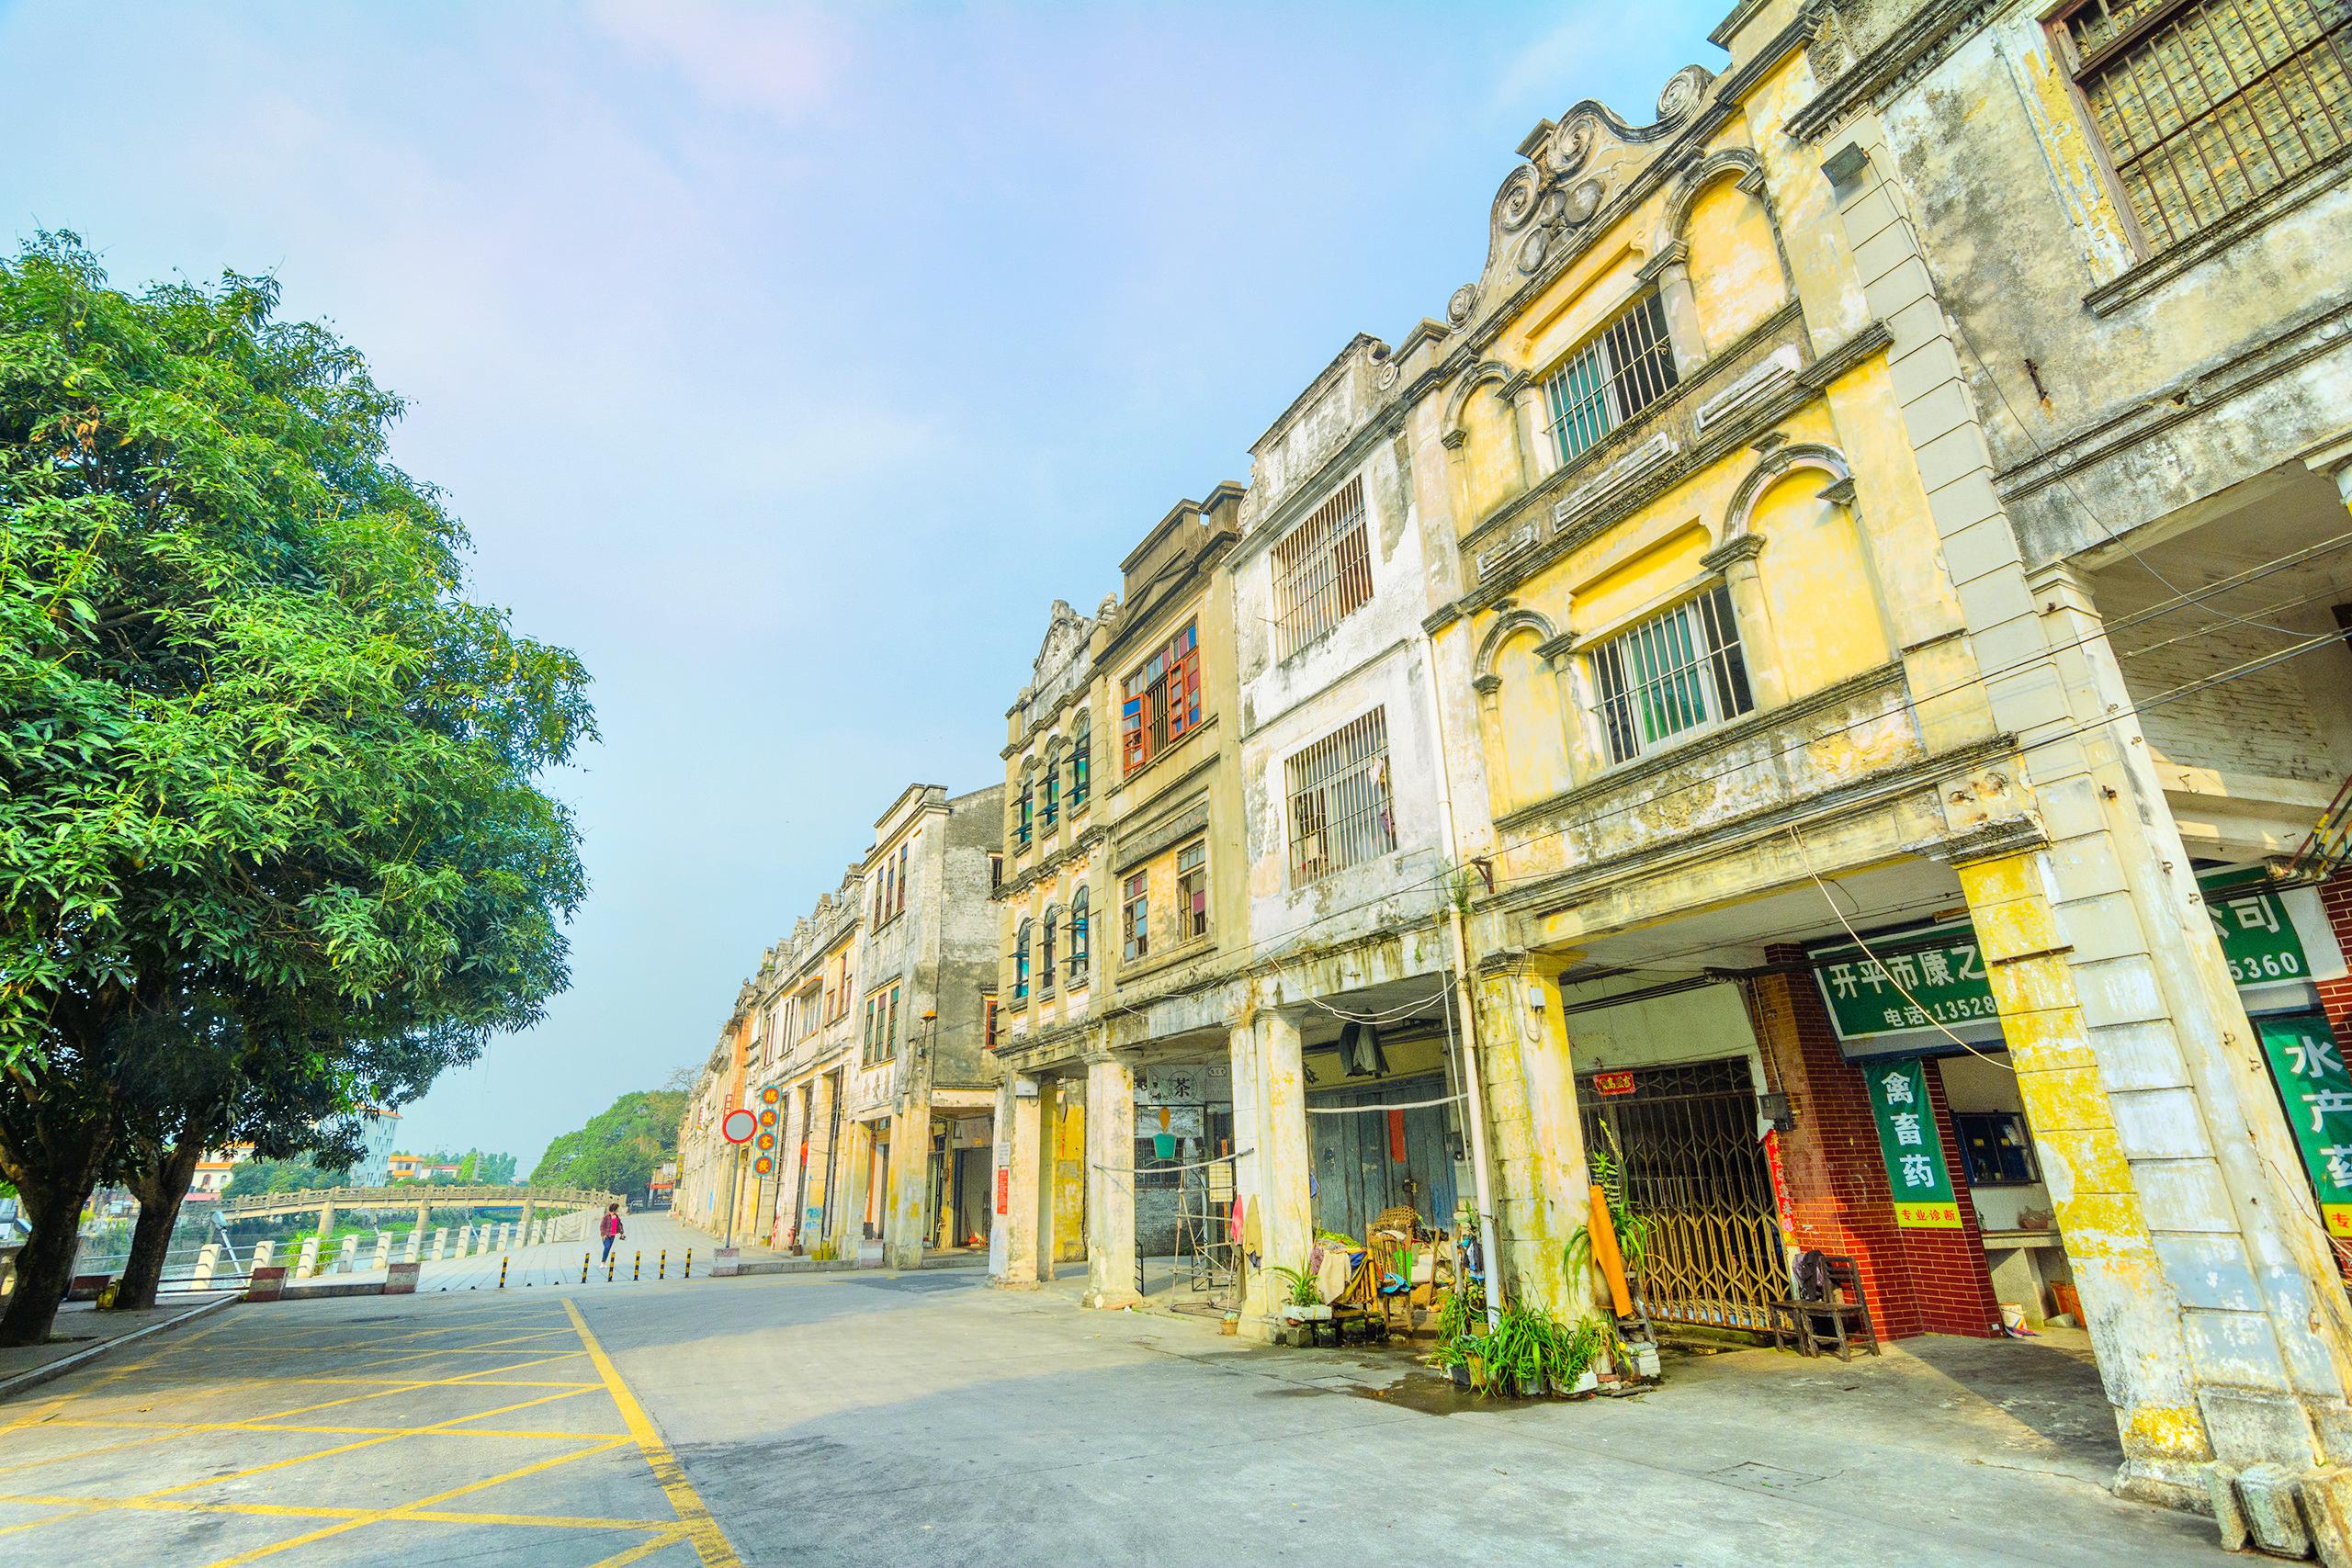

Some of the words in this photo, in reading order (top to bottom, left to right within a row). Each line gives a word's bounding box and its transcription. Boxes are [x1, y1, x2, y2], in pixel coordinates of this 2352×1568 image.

[1829, 945, 1986, 999] 开平市康之
[1174, 1077, 1192, 1098] 茶
[1882, 1071, 1935, 1188] 禽畜药
[1901, 1209, 1955, 1222] 专业诊断
